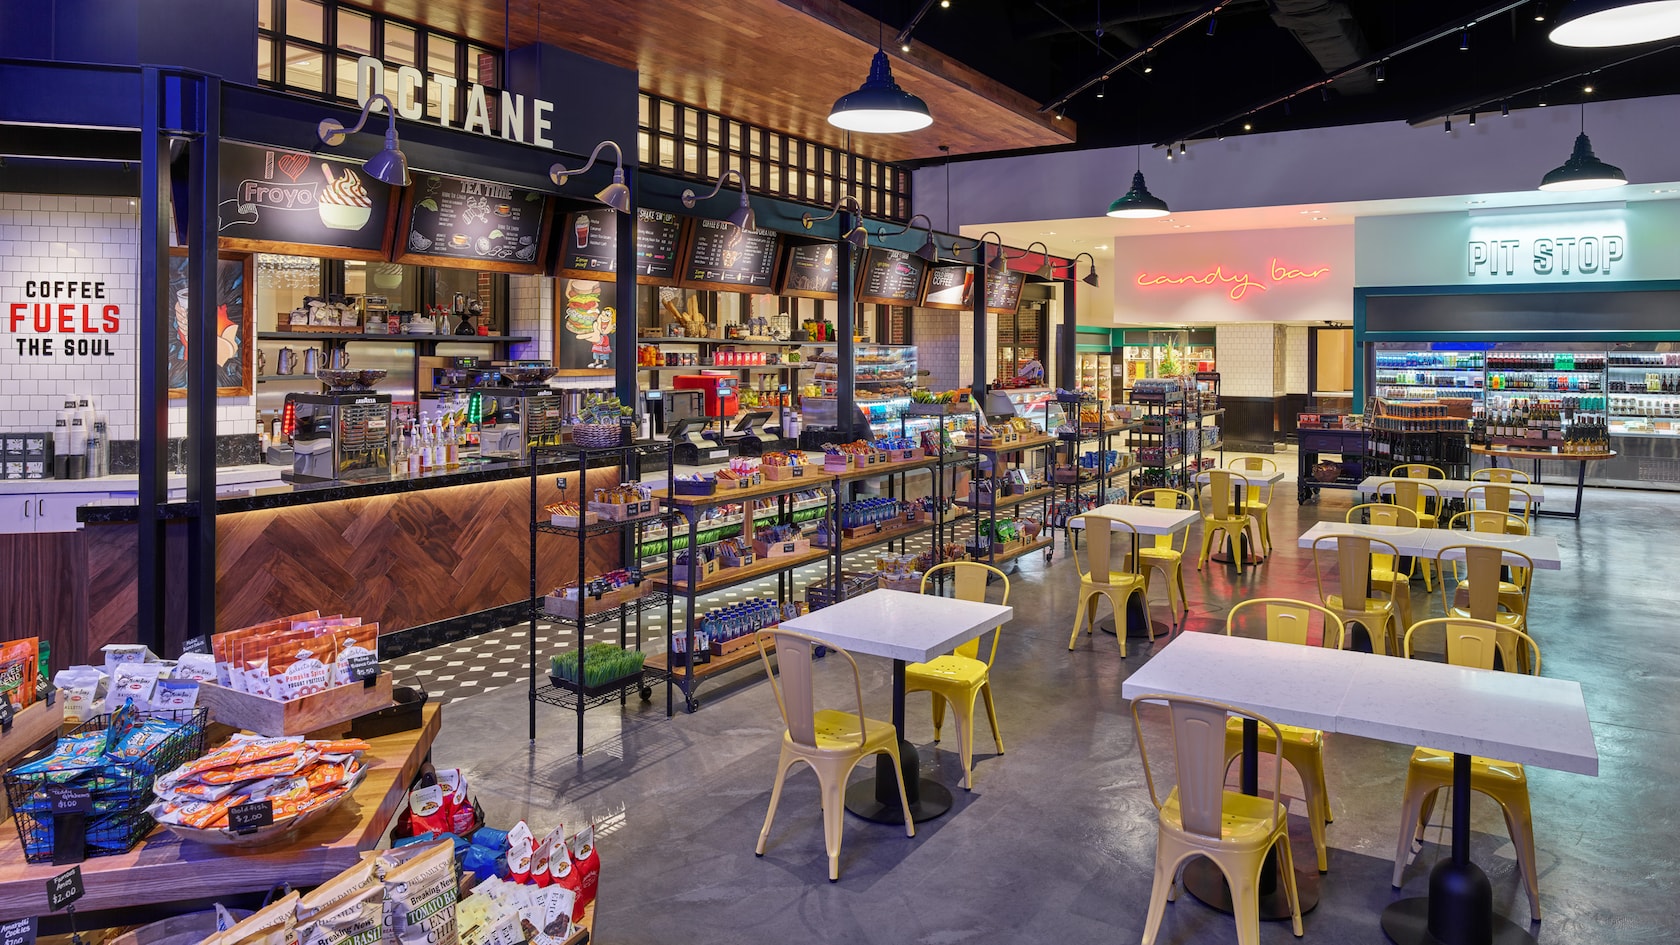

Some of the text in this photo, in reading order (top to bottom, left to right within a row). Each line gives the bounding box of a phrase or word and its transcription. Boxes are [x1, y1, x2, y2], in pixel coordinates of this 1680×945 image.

[357, 55, 554, 149] OCTANE
[264, 151, 275, 180] I
[244, 182, 313, 208] Froyo
[460, 180, 514, 201] TEA TIME
[1467, 235, 1624, 276] PIT STOP
[932, 277, 953, 287] COFFEE
[1137, 257, 1329, 300] candy bar
[26, 280, 105, 299] COFFEE
[9, 303, 120, 333] FUELS
[16, 338, 115, 356] THE SOUL
[285, 672, 310, 683] Pumpkin
[311, 669, 325, 679] Spice
[288, 680, 306, 689] YOGURT
[53, 868, 76, 884] Famous
[421, 865, 441, 880] DAILY
[56, 878, 72, 891] Amos
[52, 887, 76, 904] $2.00
[410, 884, 441, 906] Breaking
[408, 896, 444, 924] TOMATO
[4, 925, 31, 939] Cookies
[317, 917, 375, 945] Breaking News
